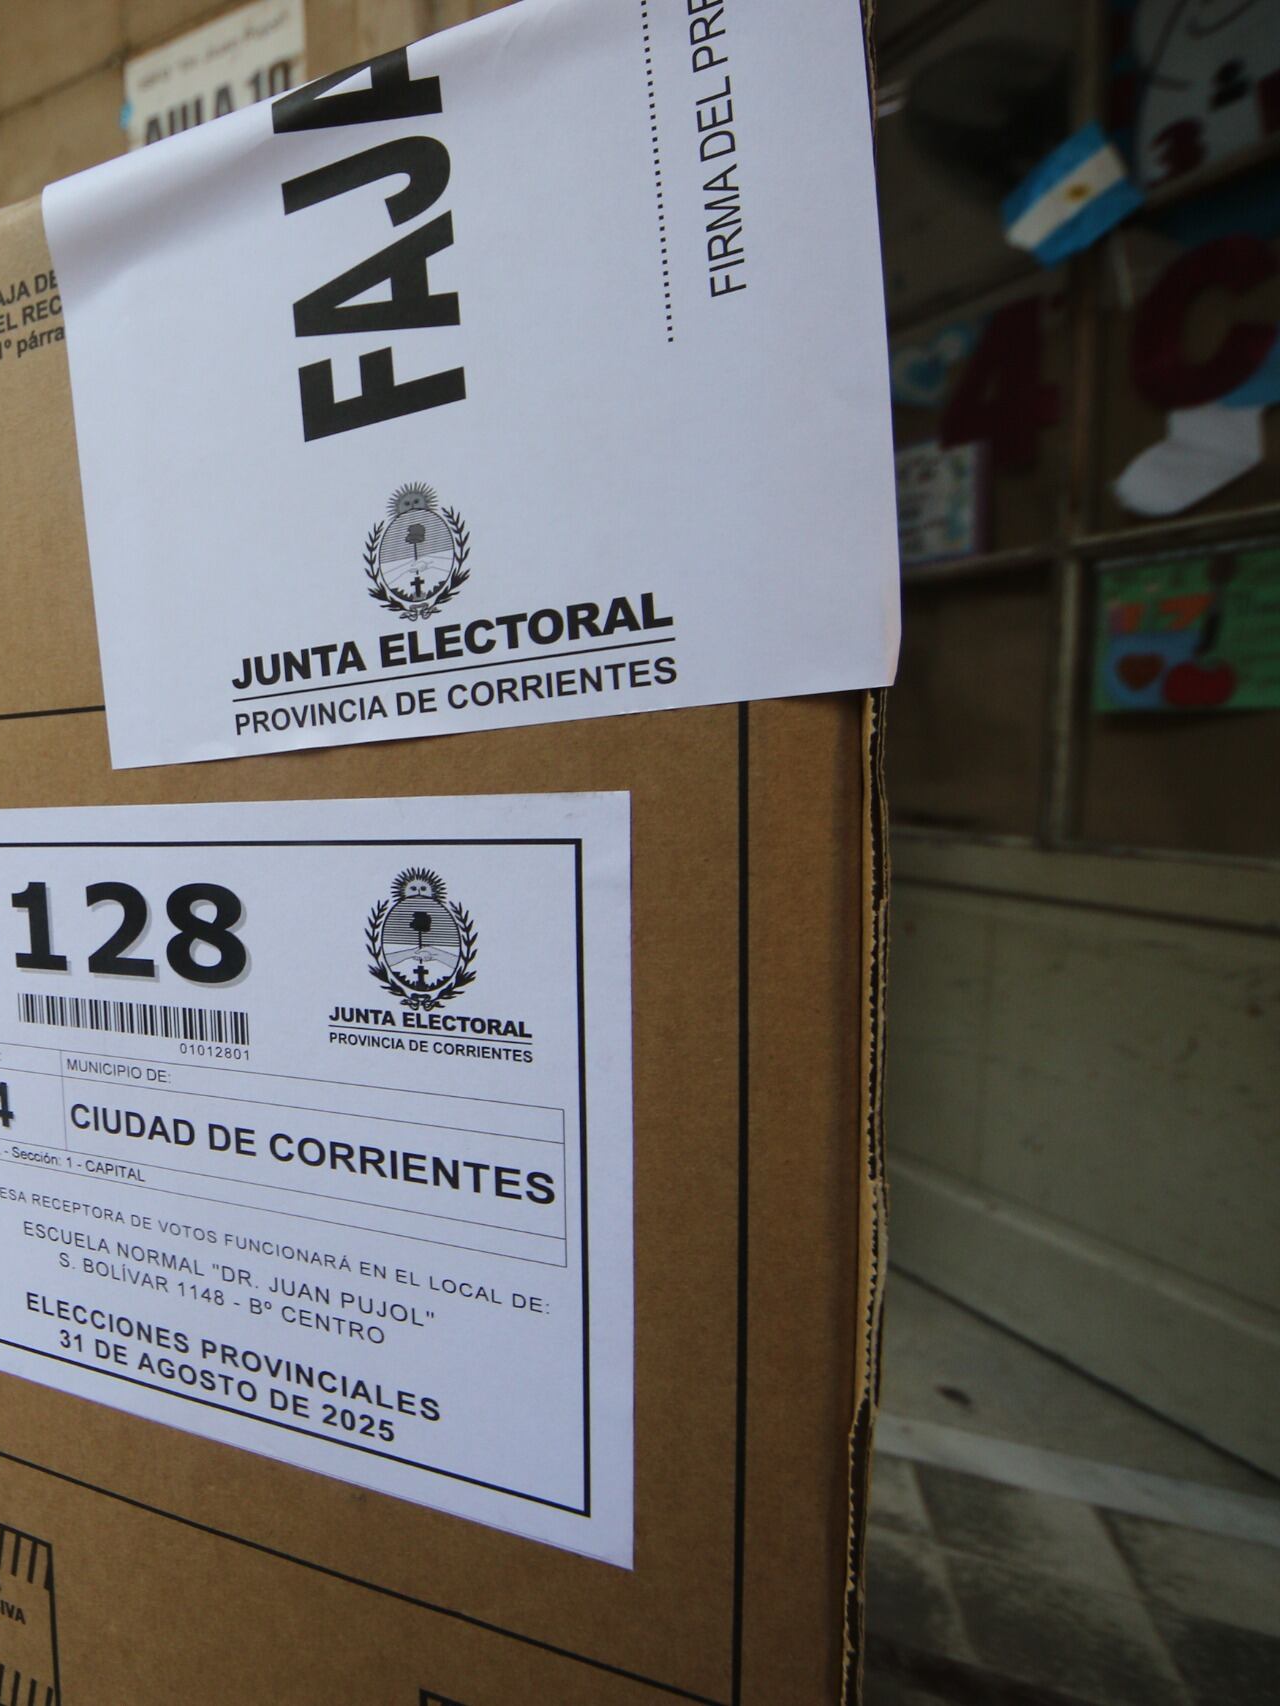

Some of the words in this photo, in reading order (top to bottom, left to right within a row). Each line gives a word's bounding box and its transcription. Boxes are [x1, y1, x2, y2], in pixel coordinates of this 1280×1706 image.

[695, 75, 734, 162] DEL
[271, 46, 467, 442] FAJA
[703, 163, 747, 298] FIRMA
[17, 325, 66, 359] párra
[22, 295, 63, 327] REC
[231, 640, 368, 690] JUNTA
[378, 592, 674, 669] ELECTORAL
[234, 695, 389, 736] PROVINCIA
[396, 687, 438, 717] DE
[447, 656, 678, 710] CORRIENTES
[178, 1042, 251, 1061] 01012801
[328, 1006, 396, 1027] JUNTA
[402, 1011, 533, 1039] ELECTORAL
[329, 1032, 405, 1050] PROVINCIA
[409, 1039, 429, 1053] DE
[433, 1041, 534, 1064] CORRIENTES
[66, 1058, 143, 1080] MUNICIPIO
[146, 1068, 172, 1084] DE:
[11, 1145, 62, 1167] Sección:
[85, 1159, 146, 1183] CAPITAL
[70, 1103, 196, 1147] CIUDAD
[207, 1123, 258, 1158] DE
[268, 1132, 557, 1206] CORRIENTES
[23, 1220, 110, 1253] ESCUELA
[117, 1241, 206, 1278] NORMAL
[211, 1263, 260, 1290] "DR.
[268, 1277, 331, 1306] JUAN
[340, 1291, 436, 1328] PUJOL"
[31, 1193, 125, 1224] RECEPTORA
[130, 1214, 152, 1230] DE
[158, 1219, 218, 1244] VOTOS
[224, 1233, 352, 1273] FUNCIONARÁ
[360, 1260, 387, 1280] EN
[395, 1268, 421, 1288] EL
[428, 1275, 503, 1306] LOCAL
[512, 1292, 552, 1316] DE:
[58, 1251, 76, 1271] S.
[82, 1257, 169, 1294] BOLÍVAR
[177, 1281, 226, 1307] 1148
[280, 1304, 385, 1345] CENTRO
[26, 1291, 189, 1354] ELECCIONES
[201, 1338, 441, 1423] PROVINCIALES
[59, 1328, 83, 1353] 31
[95, 1338, 128, 1367] DE
[138, 1351, 258, 1404] AGOSTO
[269, 1388, 311, 1419] DE
[322, 1403, 397, 1444] 2025
